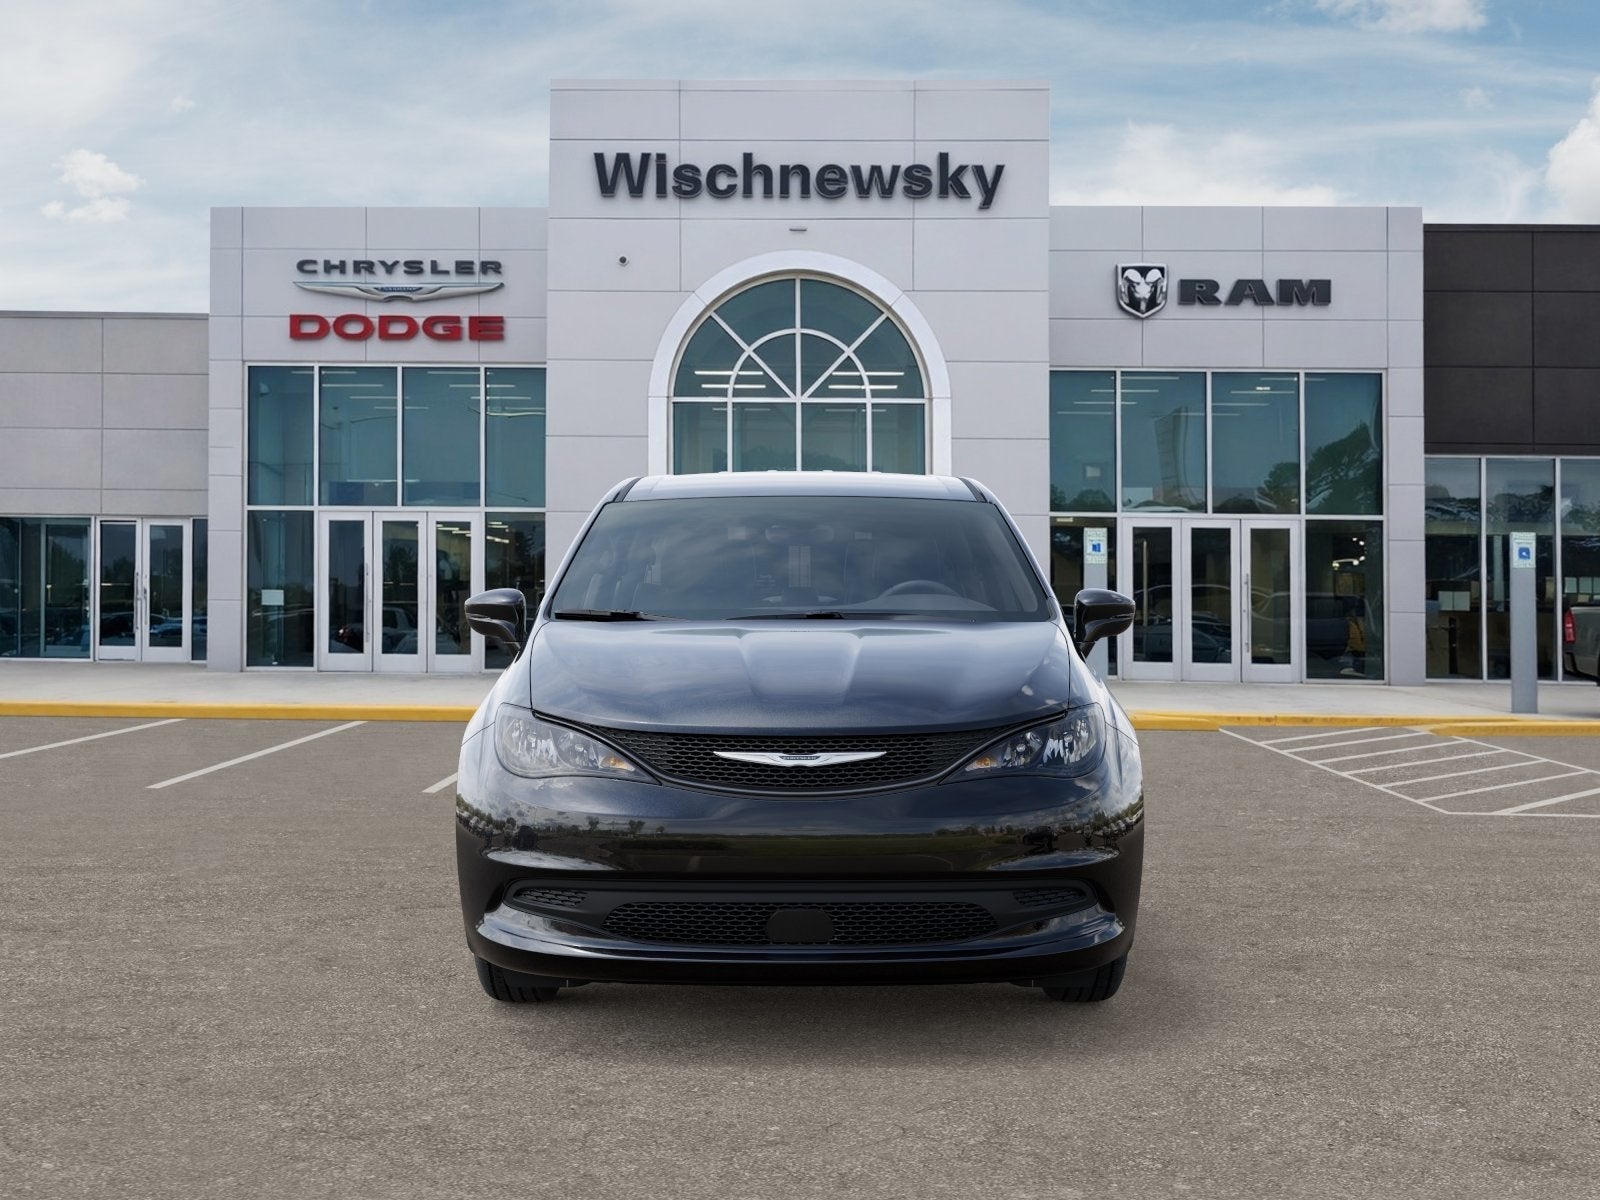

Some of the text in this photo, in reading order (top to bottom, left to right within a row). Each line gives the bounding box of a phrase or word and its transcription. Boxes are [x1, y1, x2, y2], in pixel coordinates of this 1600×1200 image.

[593, 152, 1006, 210] Wischnewsky
[296, 259, 503, 275] CHRYSLER
[1177, 278, 1332, 306] RAM
[289, 314, 505, 341] DODGE
